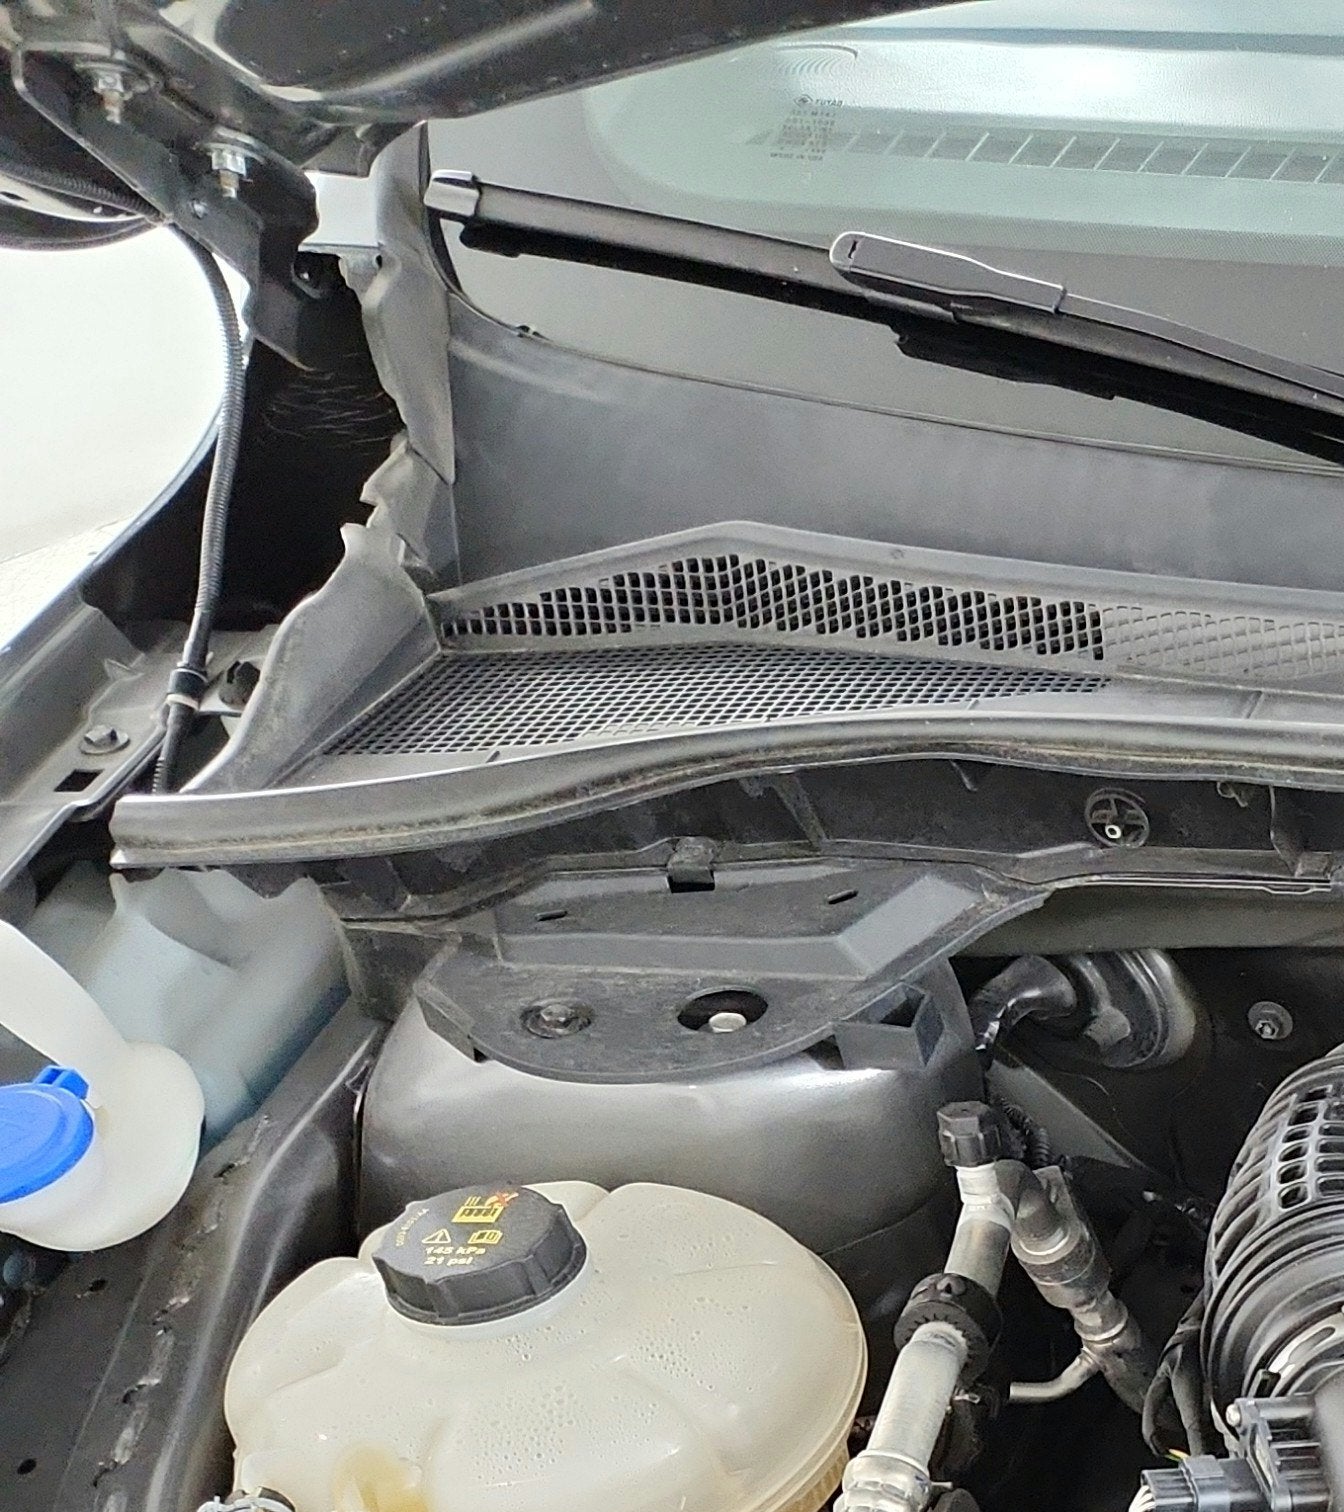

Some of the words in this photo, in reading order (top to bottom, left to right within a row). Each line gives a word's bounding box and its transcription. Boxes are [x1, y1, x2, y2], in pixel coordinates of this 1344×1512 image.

[424, 1246, 453, 1255] 145
[455, 1246, 486, 1255] kPa
[424, 1256, 443, 1265] 21
[446, 1256, 473, 1266] psi
